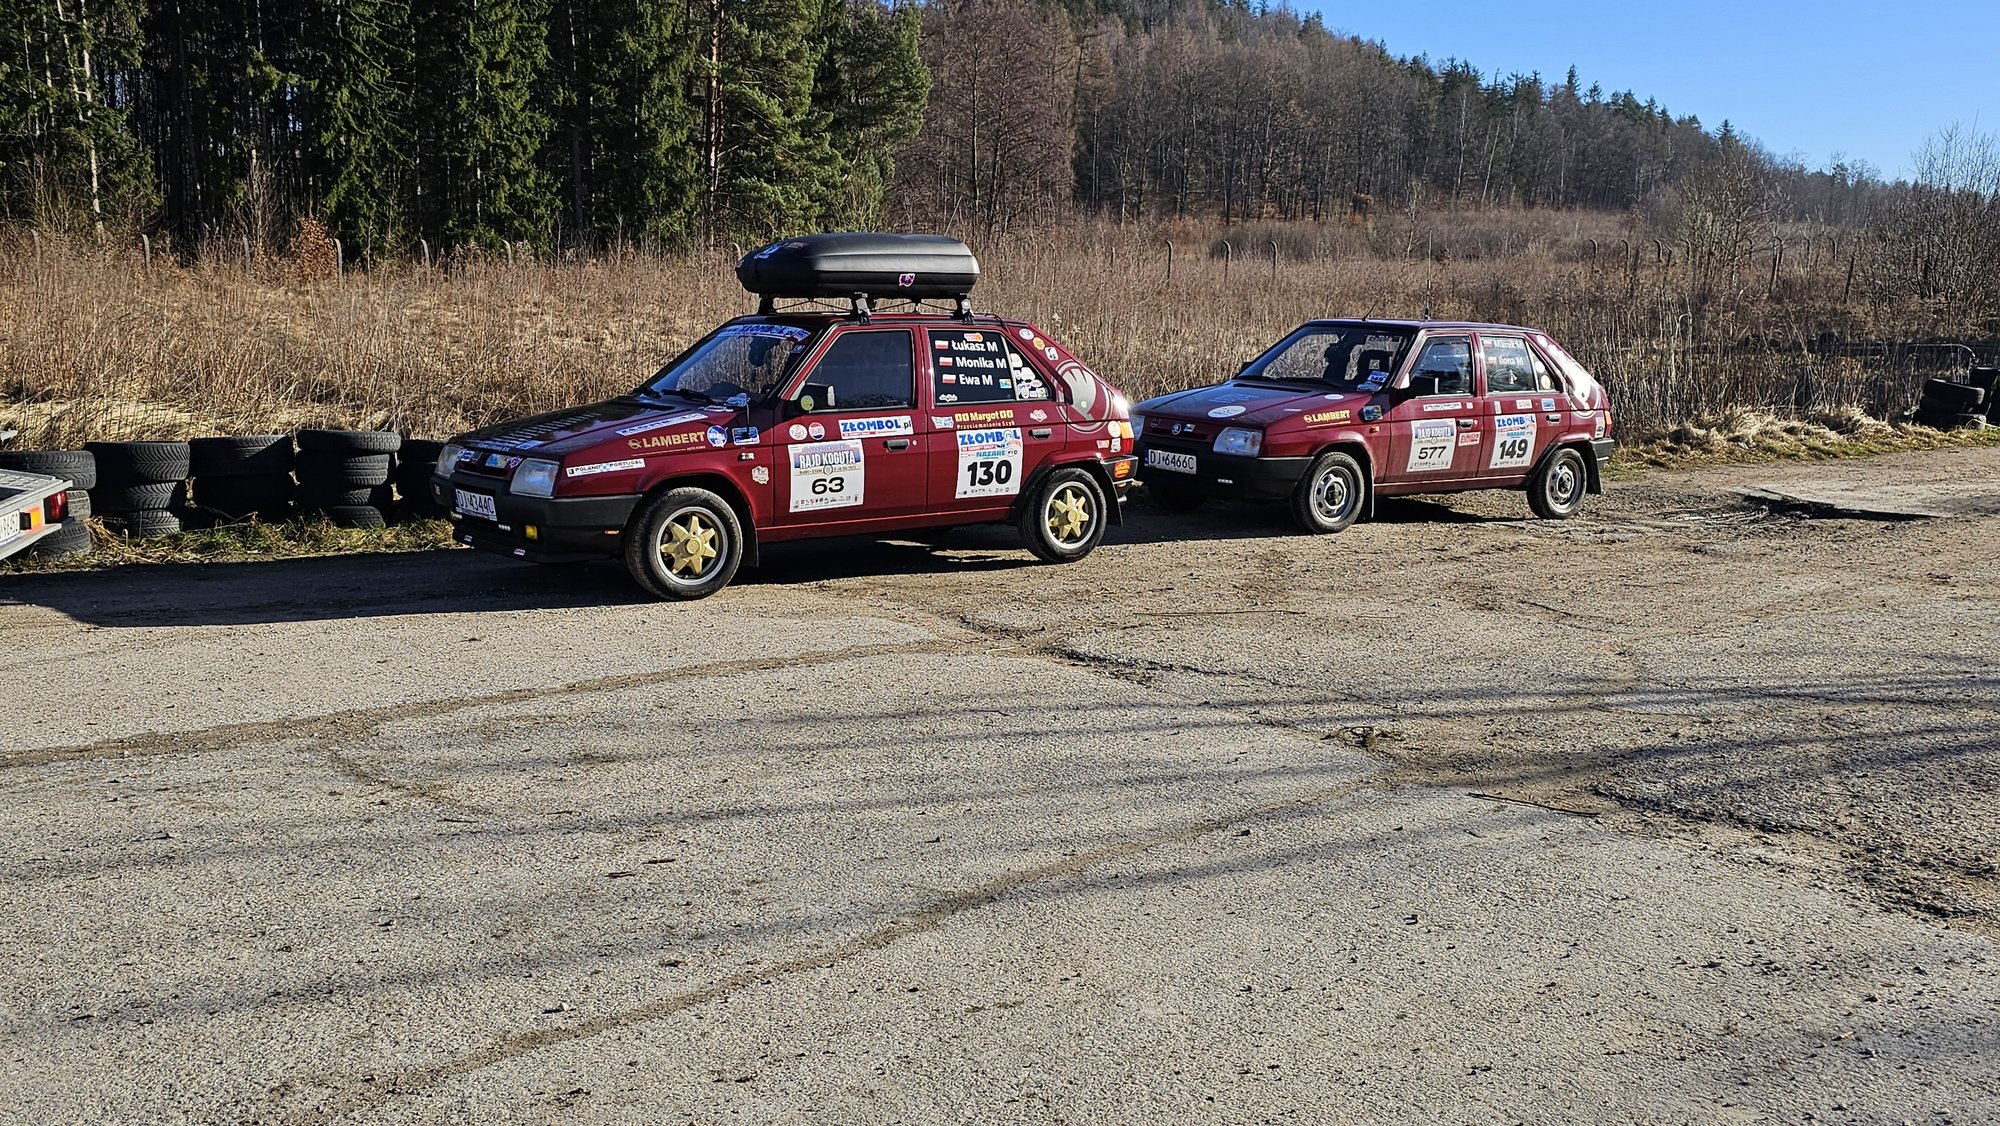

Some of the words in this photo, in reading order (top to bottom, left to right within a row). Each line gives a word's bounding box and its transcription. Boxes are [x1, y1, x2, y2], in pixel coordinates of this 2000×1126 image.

[951, 339, 986, 351] Łukasz
[986, 341, 998, 352] M
[1494, 339, 1516, 349] Marek
[955, 356, 994, 369] Monika
[995, 357, 1007, 369] M
[1515, 356, 1525, 366] M
[958, 373, 981, 386] Ewa
[981, 374, 993, 386] M
[970, 411, 999, 422] Margot
[1311, 409, 1351, 422] LAMBERT
[642, 431, 705, 448] LAMBERT
[1418, 445, 1447, 460] 577
[1499, 439, 1528, 460] 149
[575, 464, 600, 472] POLAND
[609, 459, 642, 468] PORTUGAL
[799, 452, 821, 469] RAJD
[822, 450, 856, 466] KOGUTA
[1164, 453, 1194, 470] 6466C
[967, 460, 1013, 487] 130
[811, 477, 845, 495] 63
